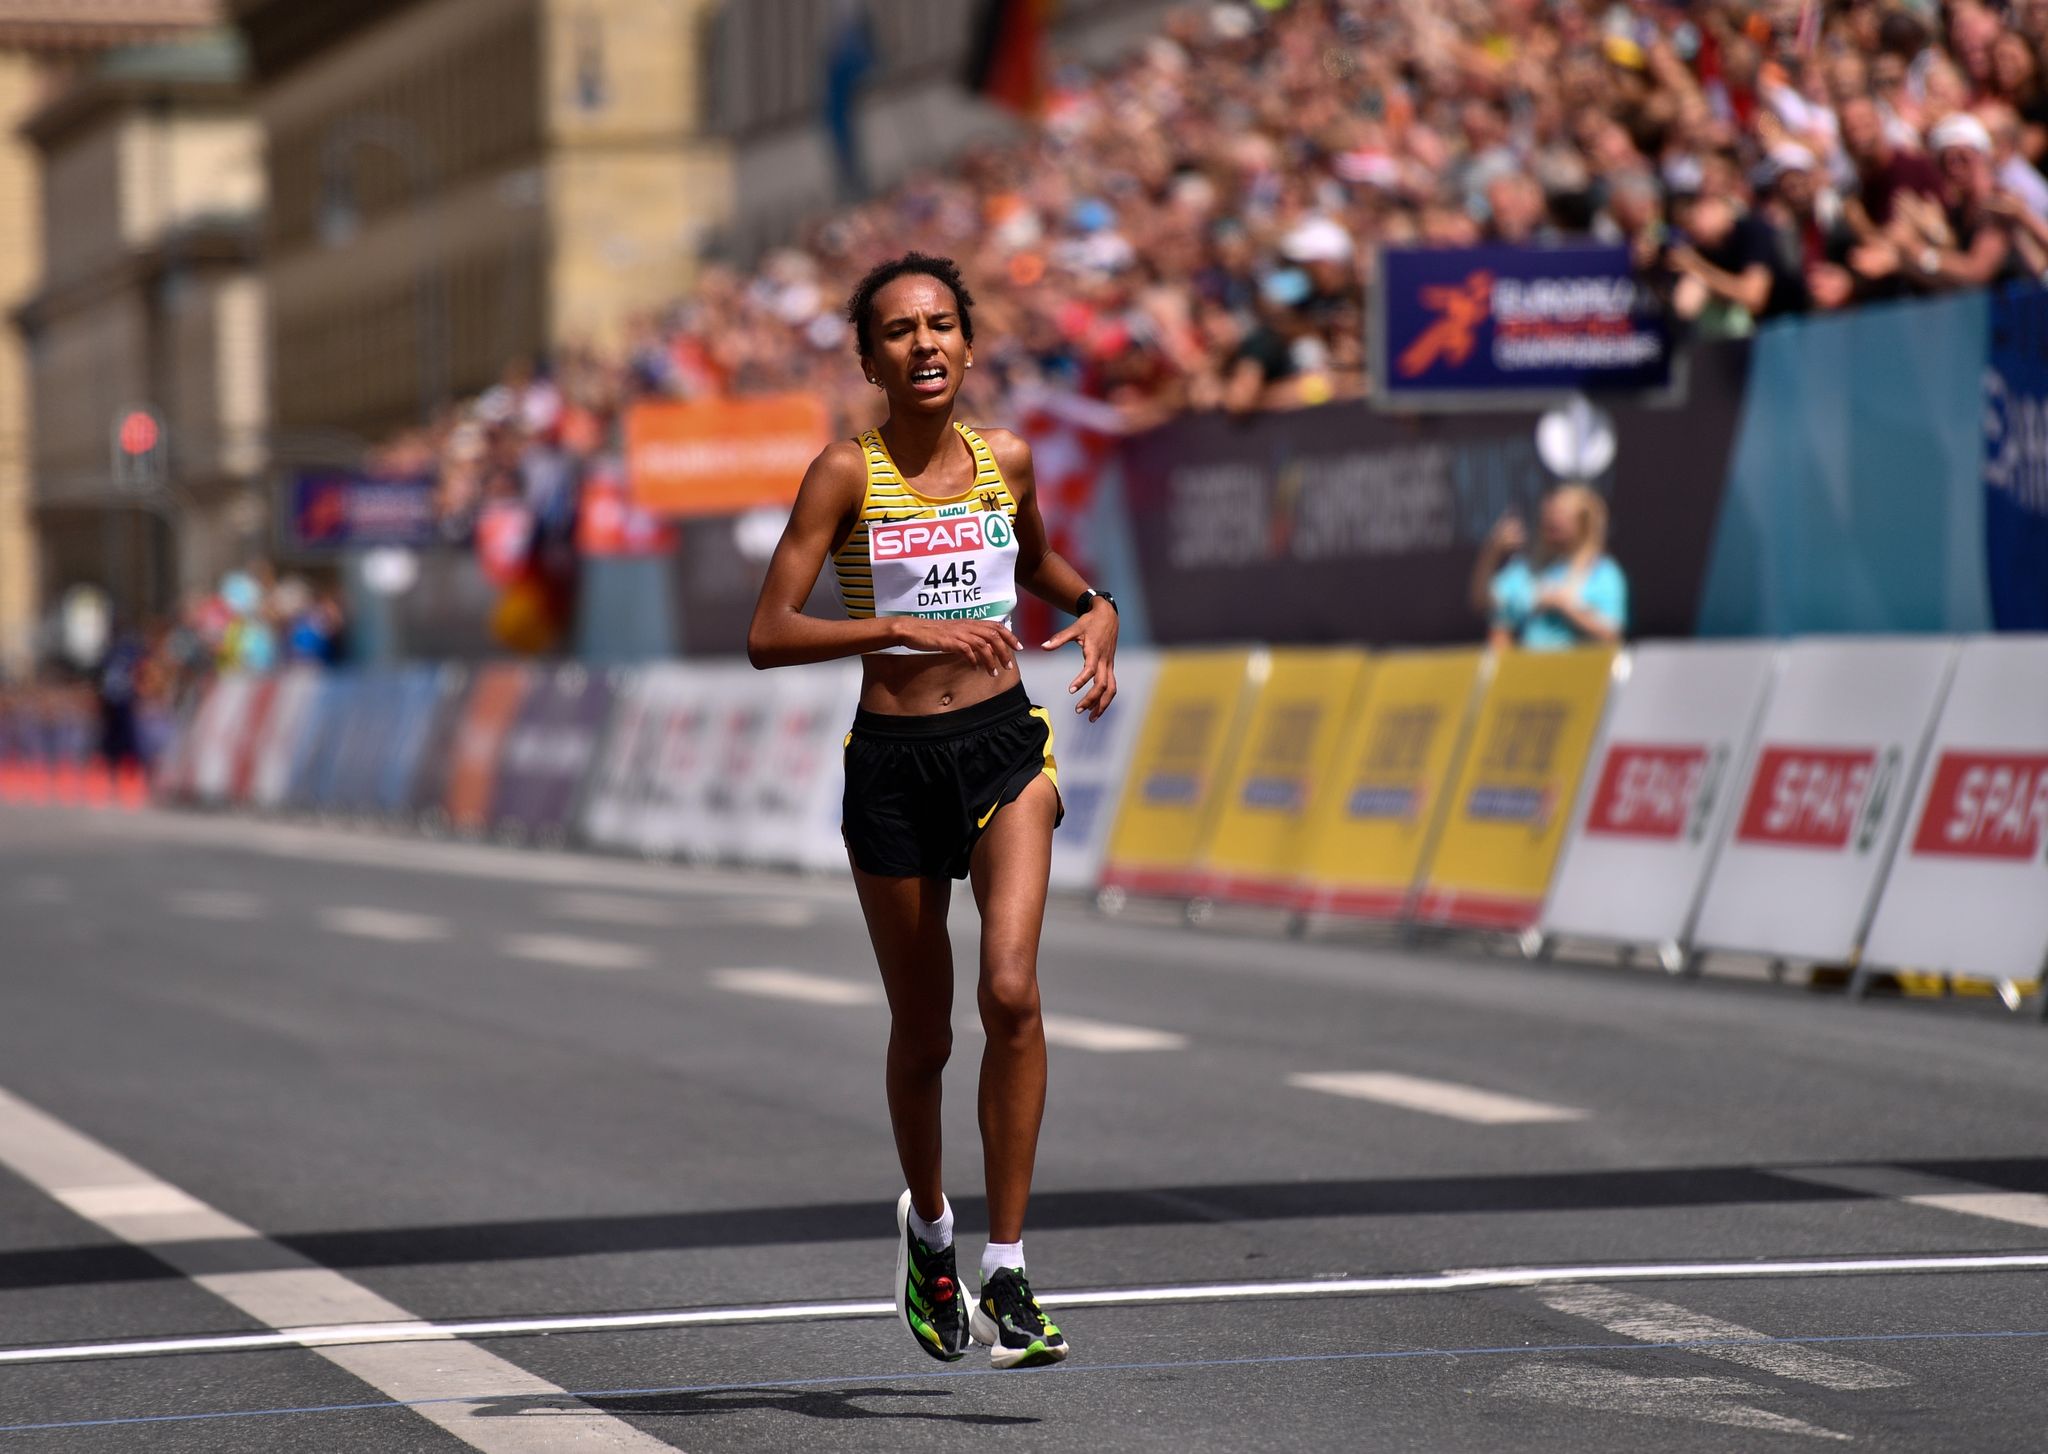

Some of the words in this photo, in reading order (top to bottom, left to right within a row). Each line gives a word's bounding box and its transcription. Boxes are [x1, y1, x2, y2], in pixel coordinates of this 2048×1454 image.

[876, 521, 981, 556] SPAR
[923, 560, 977, 589] 445
[917, 587, 982, 607] DATTKE
[1606, 756, 1704, 827] SPAR
[1763, 760, 1871, 833] SPAR
